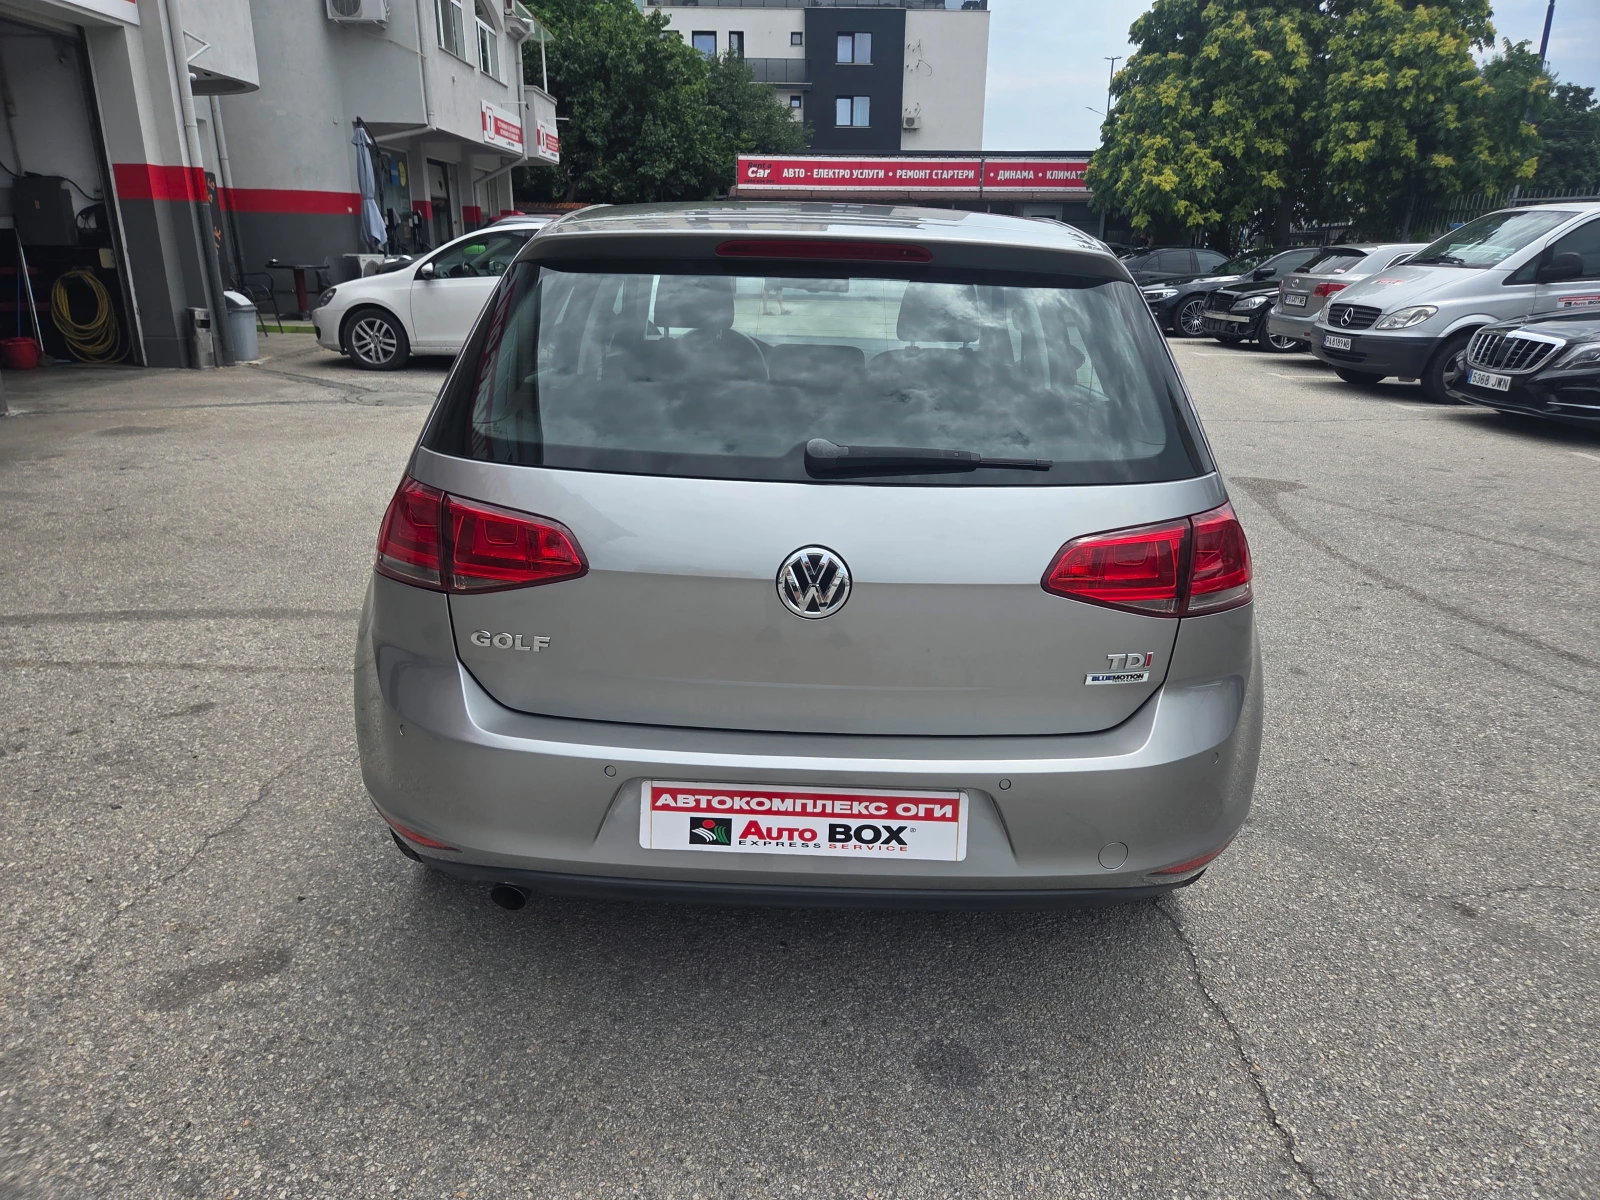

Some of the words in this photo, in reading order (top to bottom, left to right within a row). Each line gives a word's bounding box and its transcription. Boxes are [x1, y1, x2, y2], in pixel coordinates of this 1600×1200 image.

[747, 167, 771, 178] Car
[782, 168, 805, 178] АВТО
[813, 169, 850, 179] ЕЛЕКТРО
[852, 169, 885, 179] УСЛУГИ
[896, 169, 931, 179] РЕМОНТ
[932, 170, 975, 180] СТАРТЕРИ
[997, 170, 1034, 181] ДИНАМА
[1046, 170, 1085, 180] КЛИМАТ
[1472, 371, 1490, 385] 5368
[1491, 376, 1510, 390] JWN
[470, 629, 551, 652] GOLF
[1107, 652, 1154, 670] TDI
[1091, 673, 1144, 681] BLUEMOTION
[655, 793, 889, 816] АВТОКОМПЛЕКС
[895, 803, 953, 818] ОГИ
[828, 823, 908, 846] BOX
[738, 840, 821, 849] EXPRESS
[829, 843, 908, 852] SERVICE
